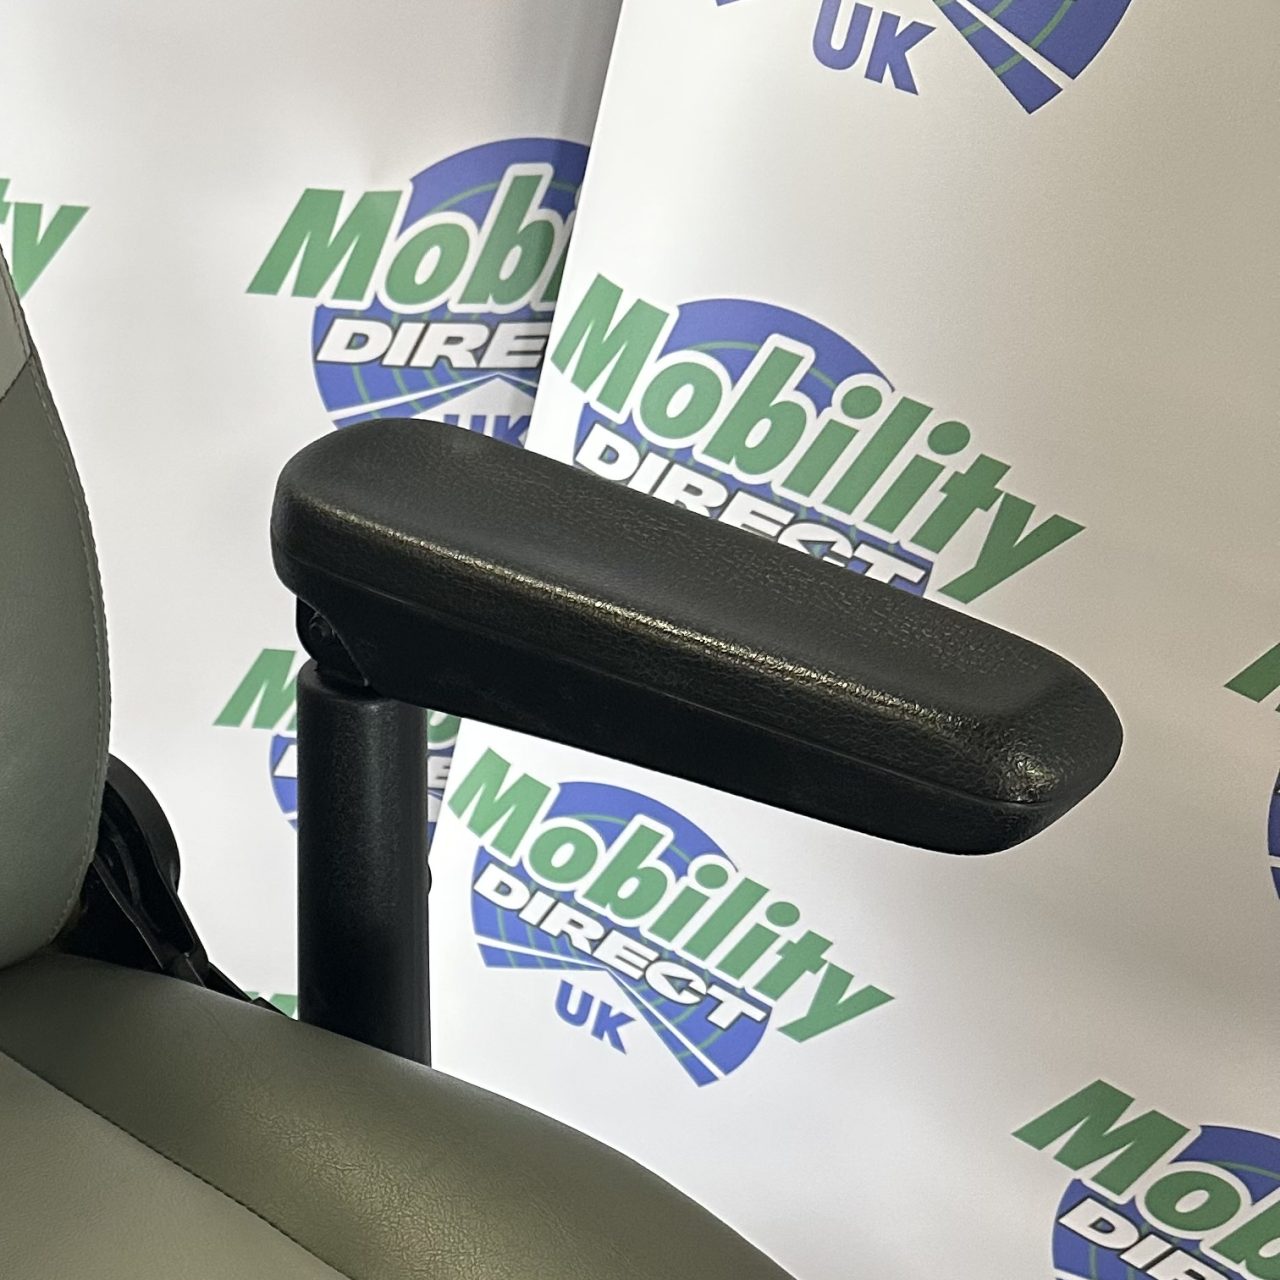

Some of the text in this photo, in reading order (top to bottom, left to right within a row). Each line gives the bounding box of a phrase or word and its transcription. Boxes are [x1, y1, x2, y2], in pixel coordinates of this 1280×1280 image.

[812, 0, 936, 96] UK
[551, 274, 1086, 605] Mobility
[448, 748, 896, 1044] Mobility
[474, 863, 767, 1030] DIRECT
[555, 979, 637, 1055] UK
